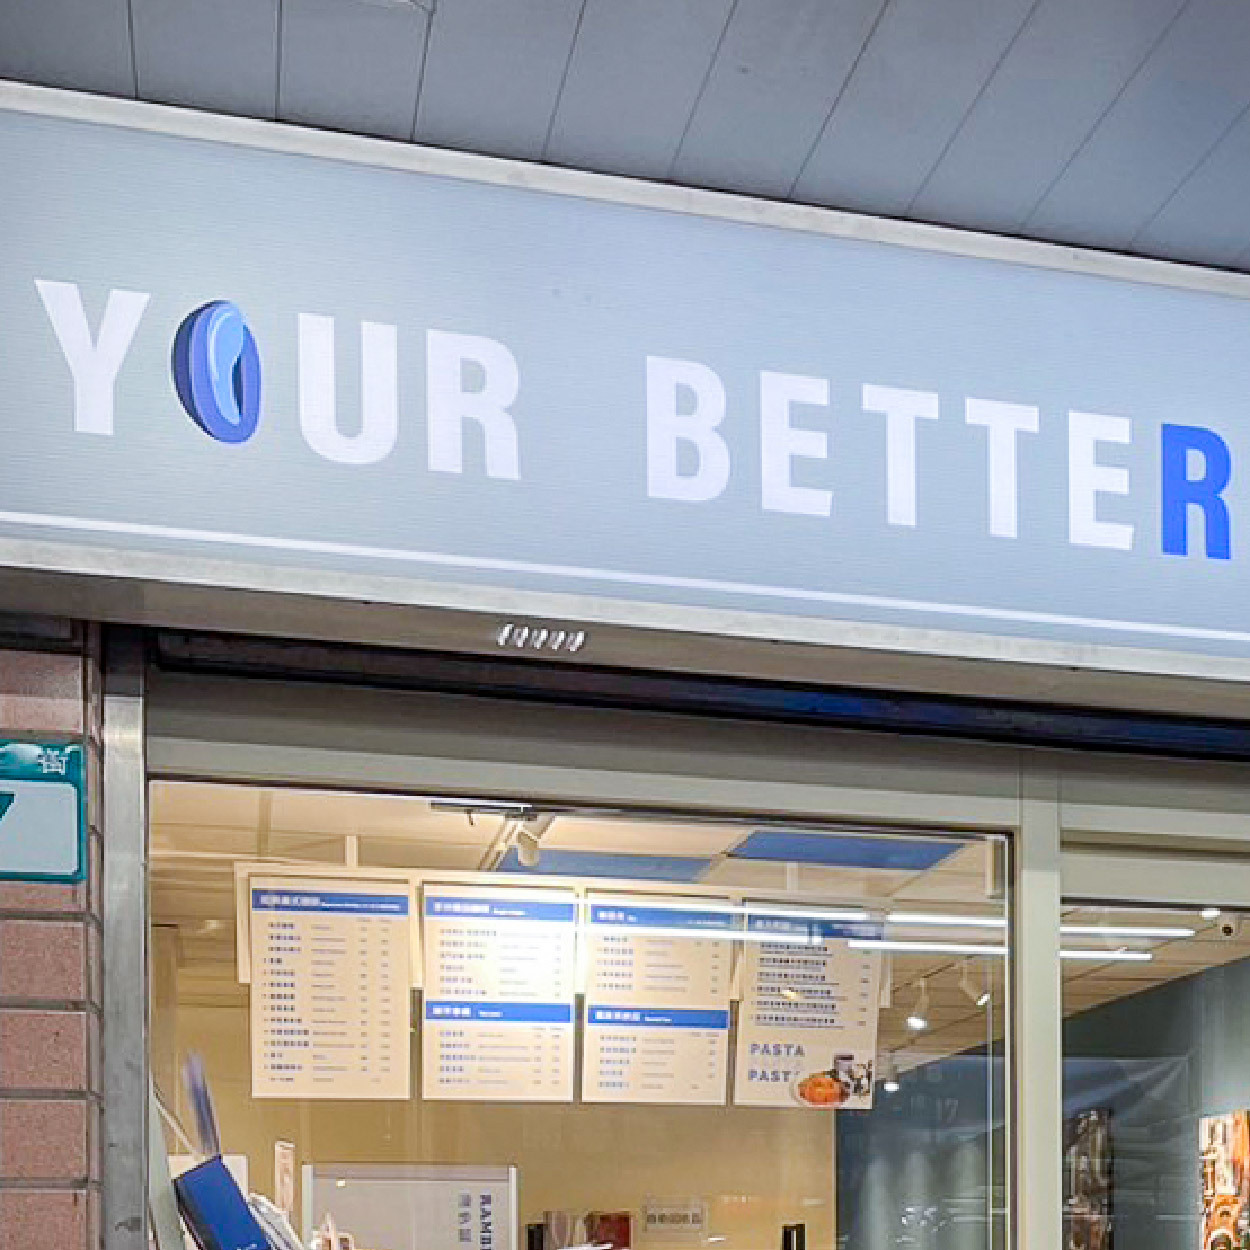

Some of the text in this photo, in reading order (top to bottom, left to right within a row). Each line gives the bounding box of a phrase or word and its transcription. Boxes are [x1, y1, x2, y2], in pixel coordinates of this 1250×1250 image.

[33, 278, 522, 481] YOUR
[645, 354, 1232, 561] BETTER
[750, 1043, 805, 1057] PASTA
[747, 1069, 801, 1083] PAST
